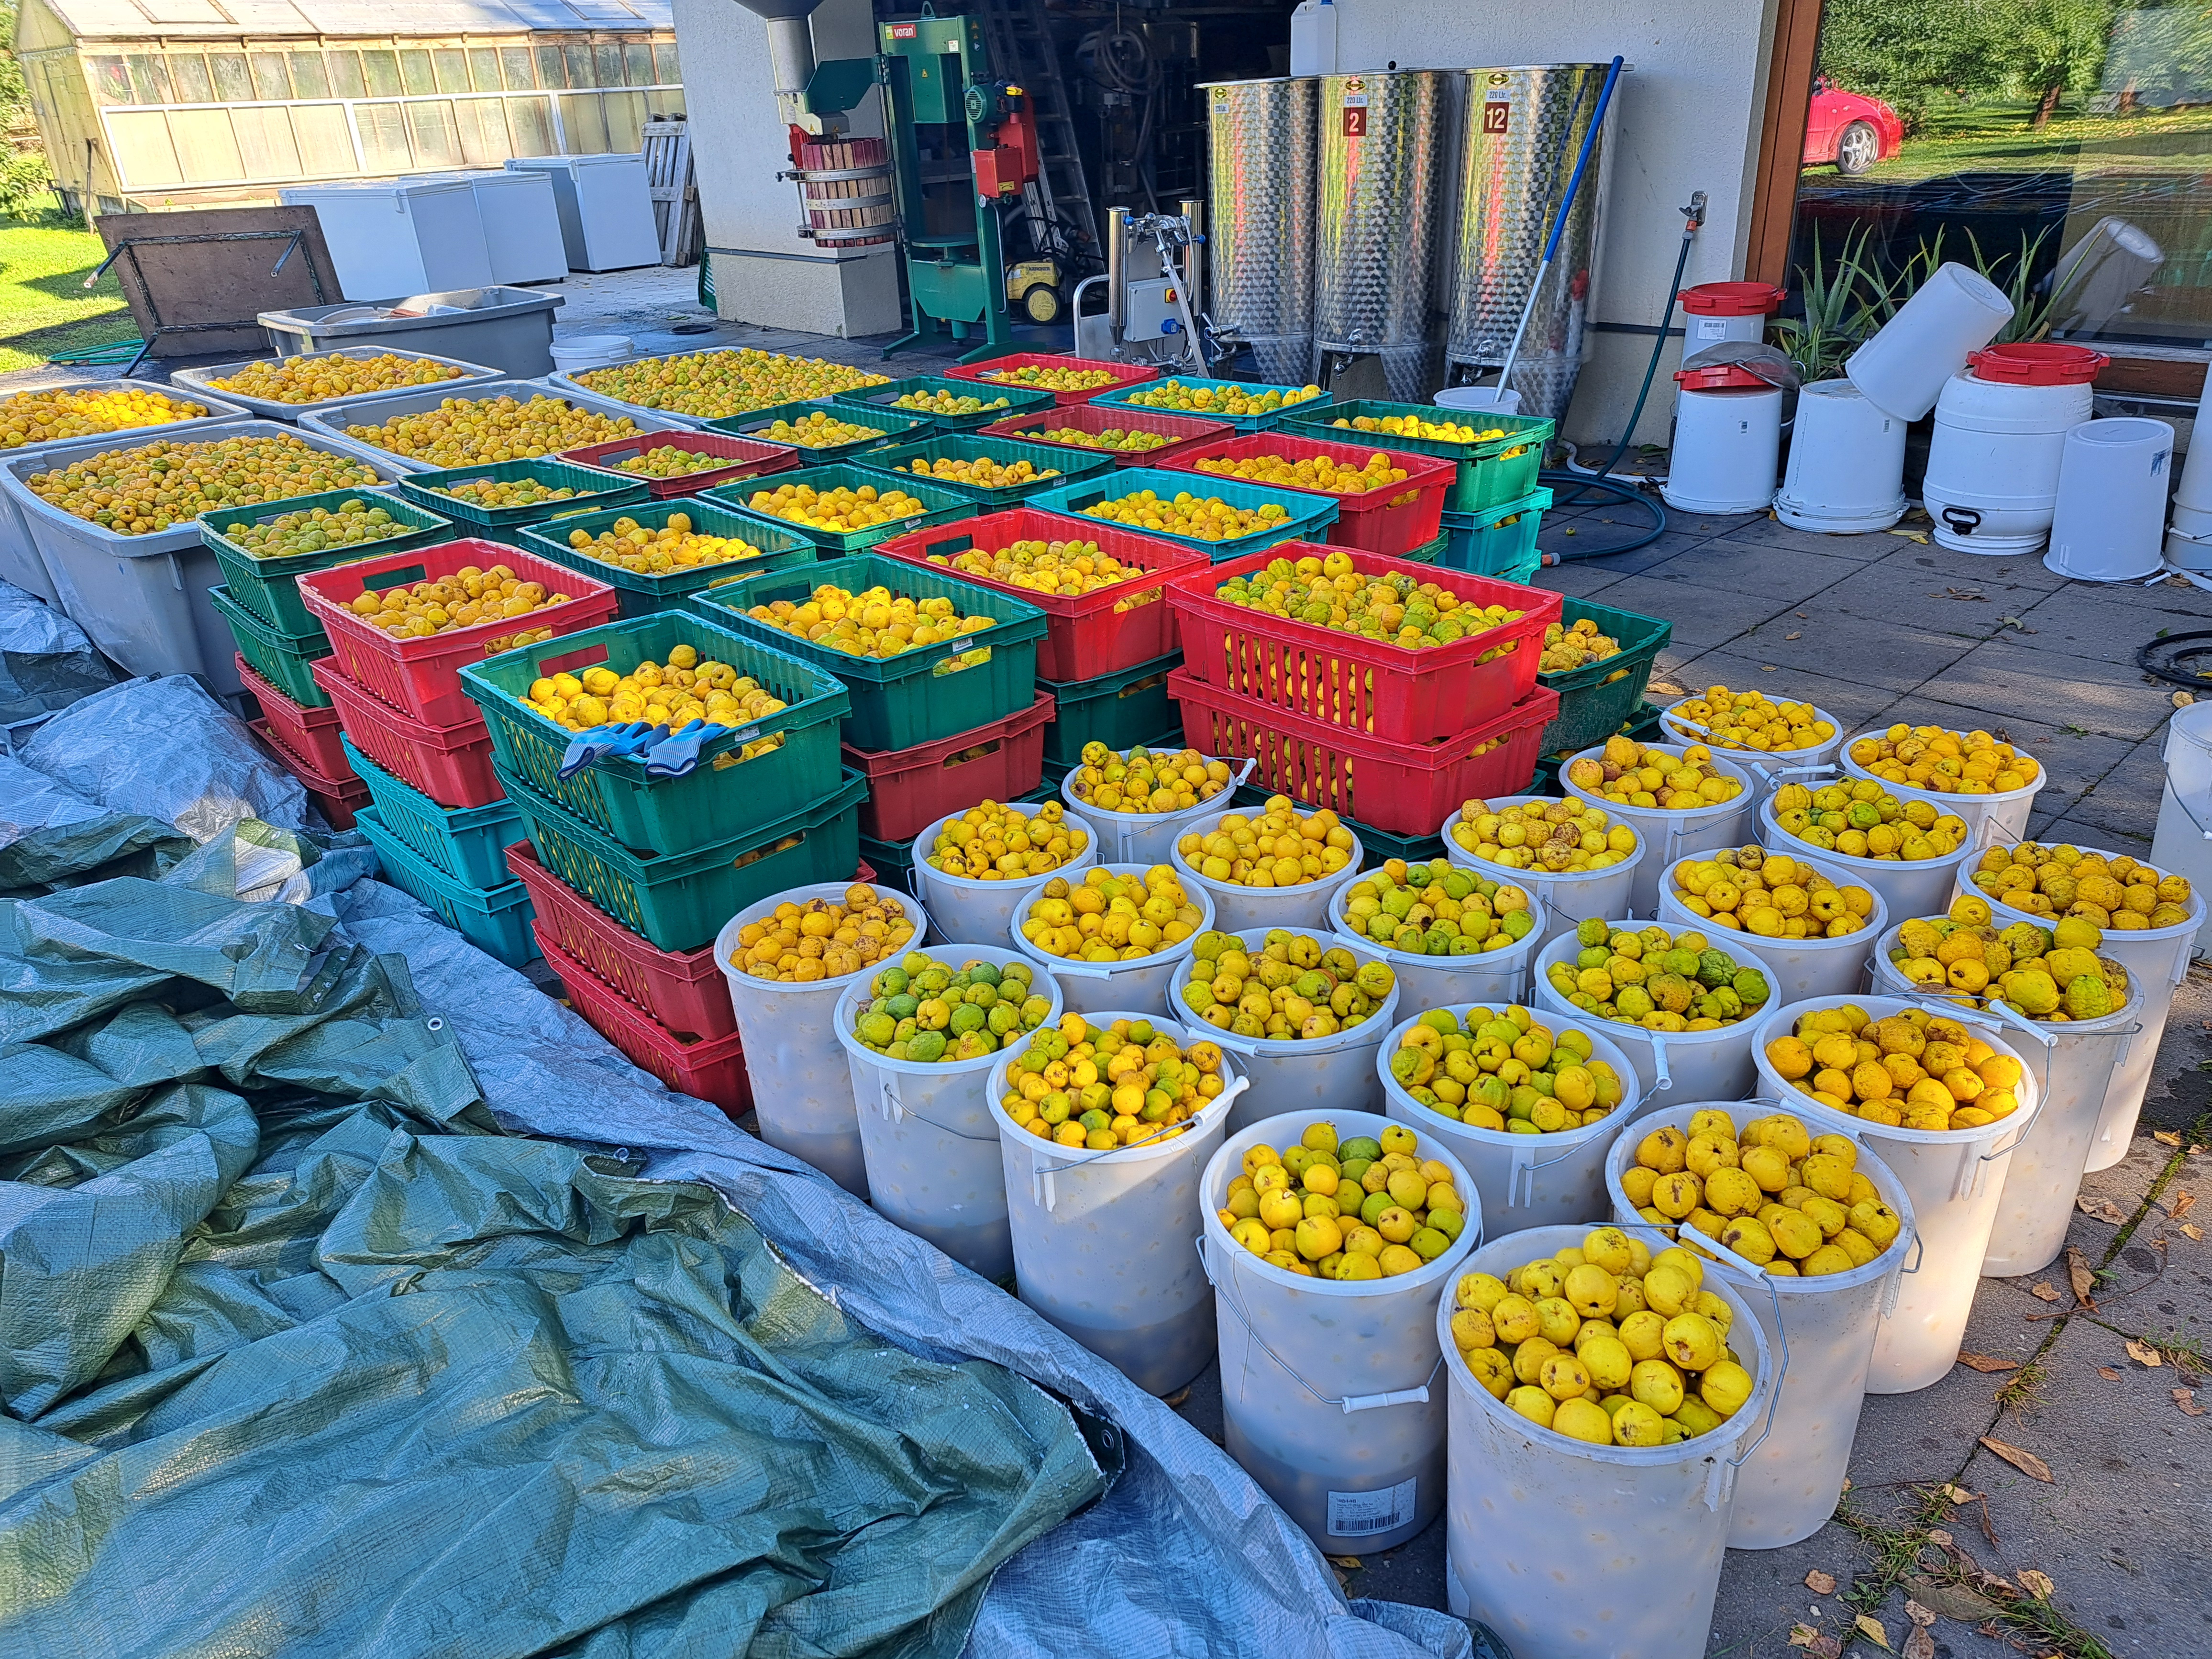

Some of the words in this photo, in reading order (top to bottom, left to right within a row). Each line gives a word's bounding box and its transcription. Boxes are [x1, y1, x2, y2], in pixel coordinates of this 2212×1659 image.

[894, 27, 914, 37] voran
[1349, 112, 1359, 132] 2
[1487, 108, 1505, 129] 12
